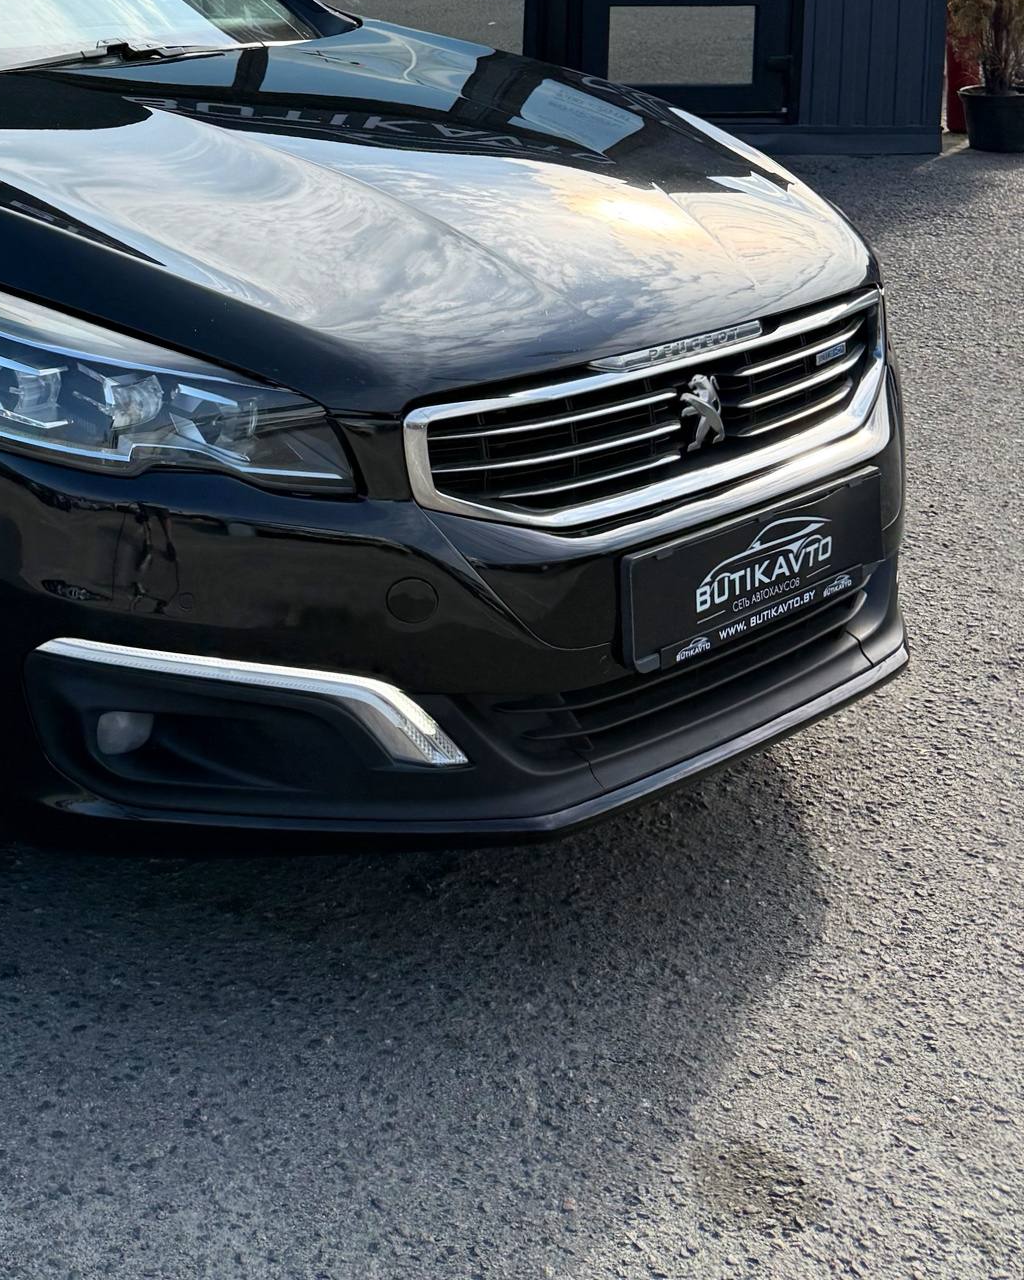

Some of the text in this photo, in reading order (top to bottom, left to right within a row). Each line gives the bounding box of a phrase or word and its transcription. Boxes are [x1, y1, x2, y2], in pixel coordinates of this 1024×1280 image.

[648, 327, 739, 361] PEUGEOT
[695, 534, 833, 613] BUTIKAVTO
[732, 576, 801, 613] СЕТЬ АВТОХАУСОВ
[719, 589, 816, 640] WWW. BUTIKAVTO.BY
